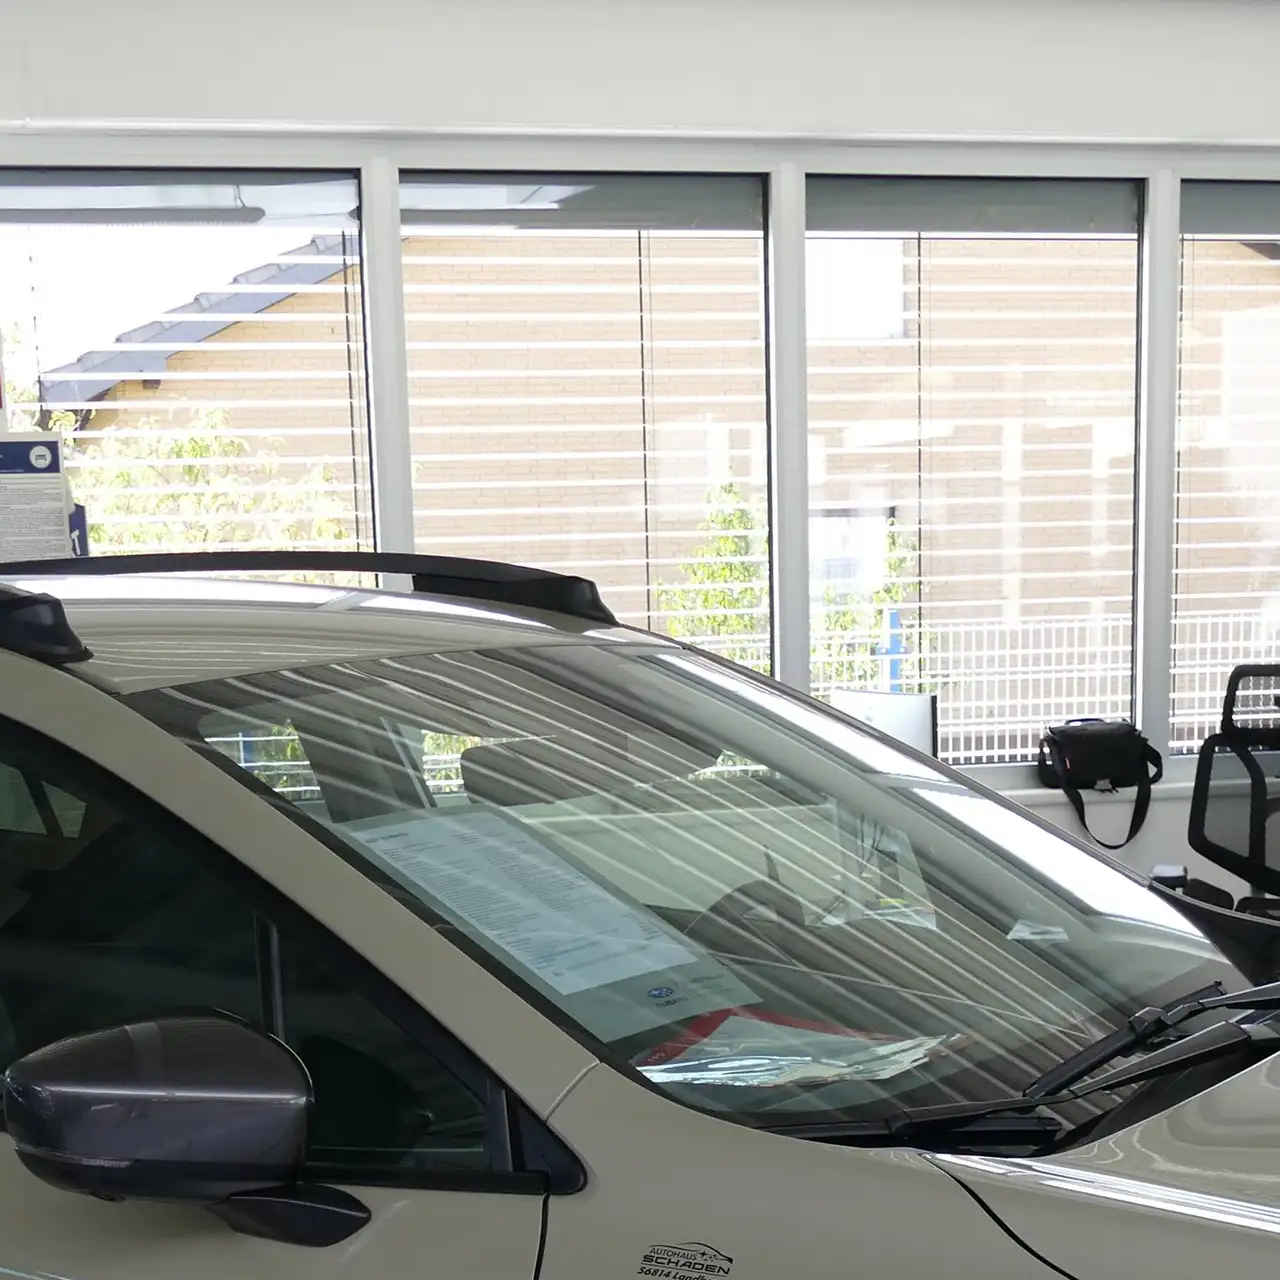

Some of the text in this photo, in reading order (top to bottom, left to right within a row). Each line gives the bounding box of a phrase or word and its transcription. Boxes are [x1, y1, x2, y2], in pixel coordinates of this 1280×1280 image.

[648, 1247, 698, 1261] AUTOHAUS
[642, 1254, 731, 1275] SCHADEN
[637, 1266, 671, 1279] 56814
